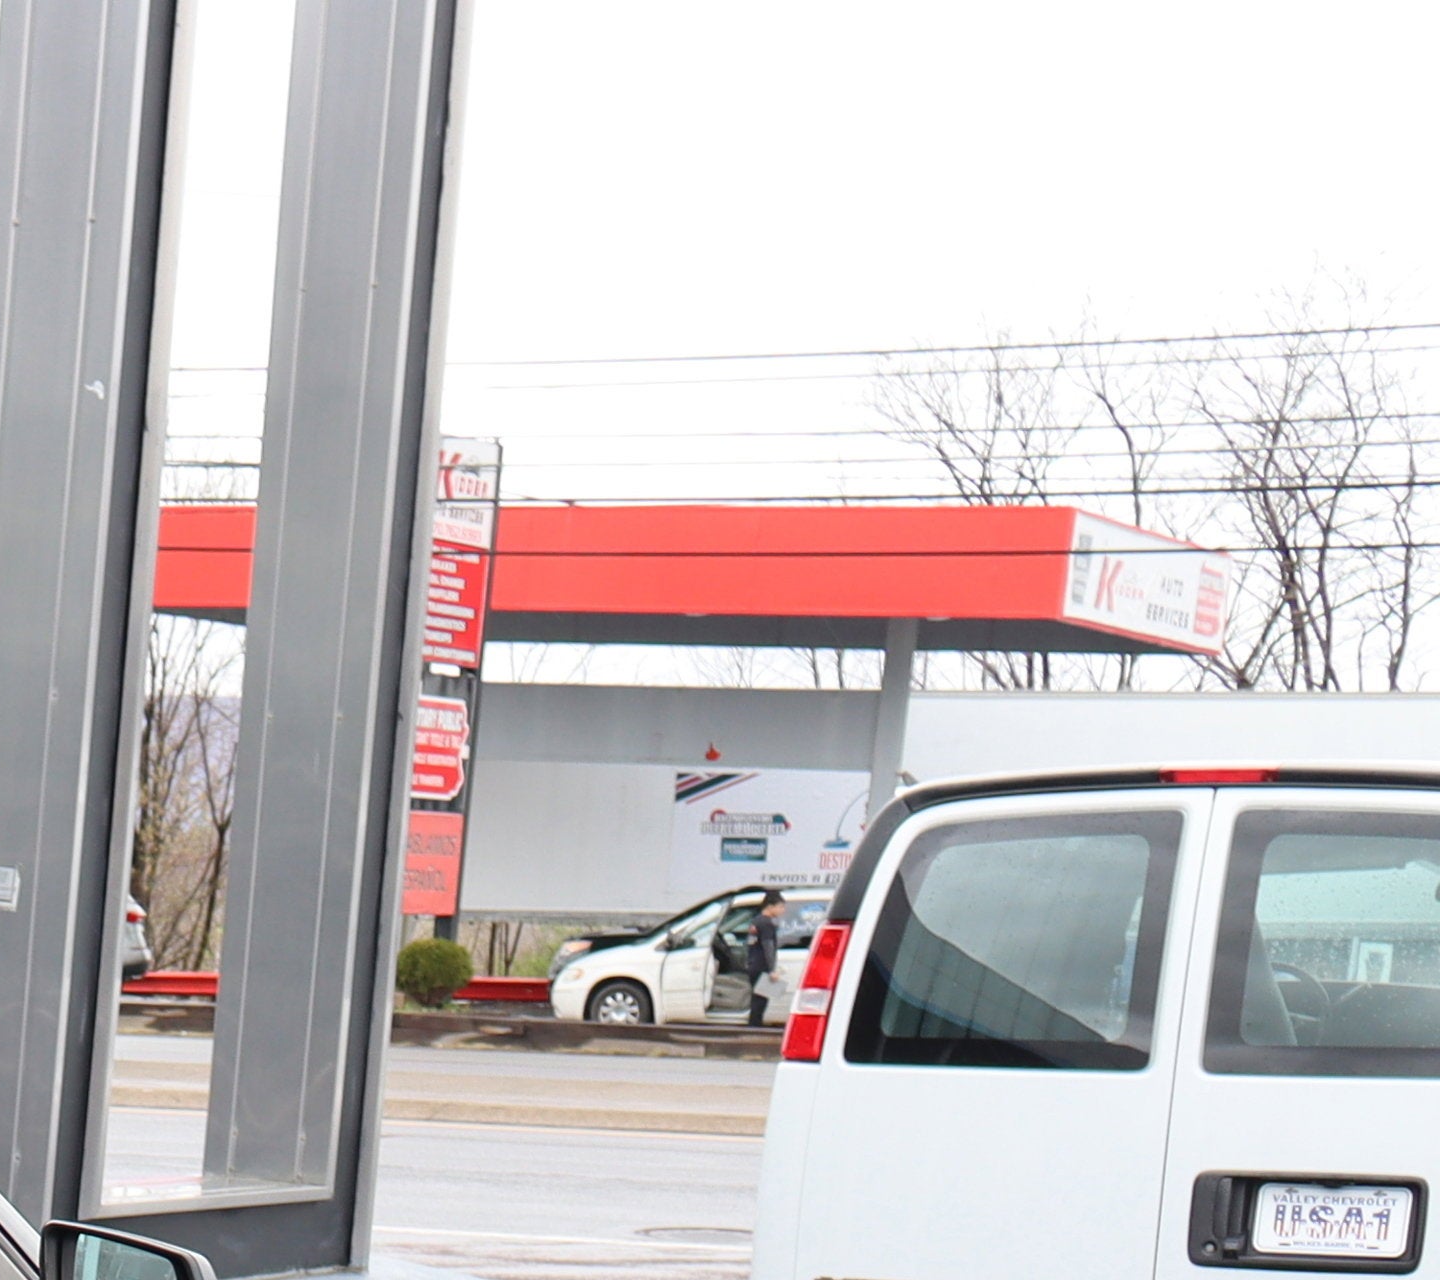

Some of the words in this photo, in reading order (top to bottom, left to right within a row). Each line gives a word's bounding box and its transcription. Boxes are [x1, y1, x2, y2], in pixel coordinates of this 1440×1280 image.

[1161, 576, 1184, 597] AUTO
[1146, 602, 1190, 629] SERVICES
[819, 852, 855, 870] DESTI
[1273, 1193, 1320, 1204] VALLEY
[1322, 1195, 1398, 1207] CHEVROLET
